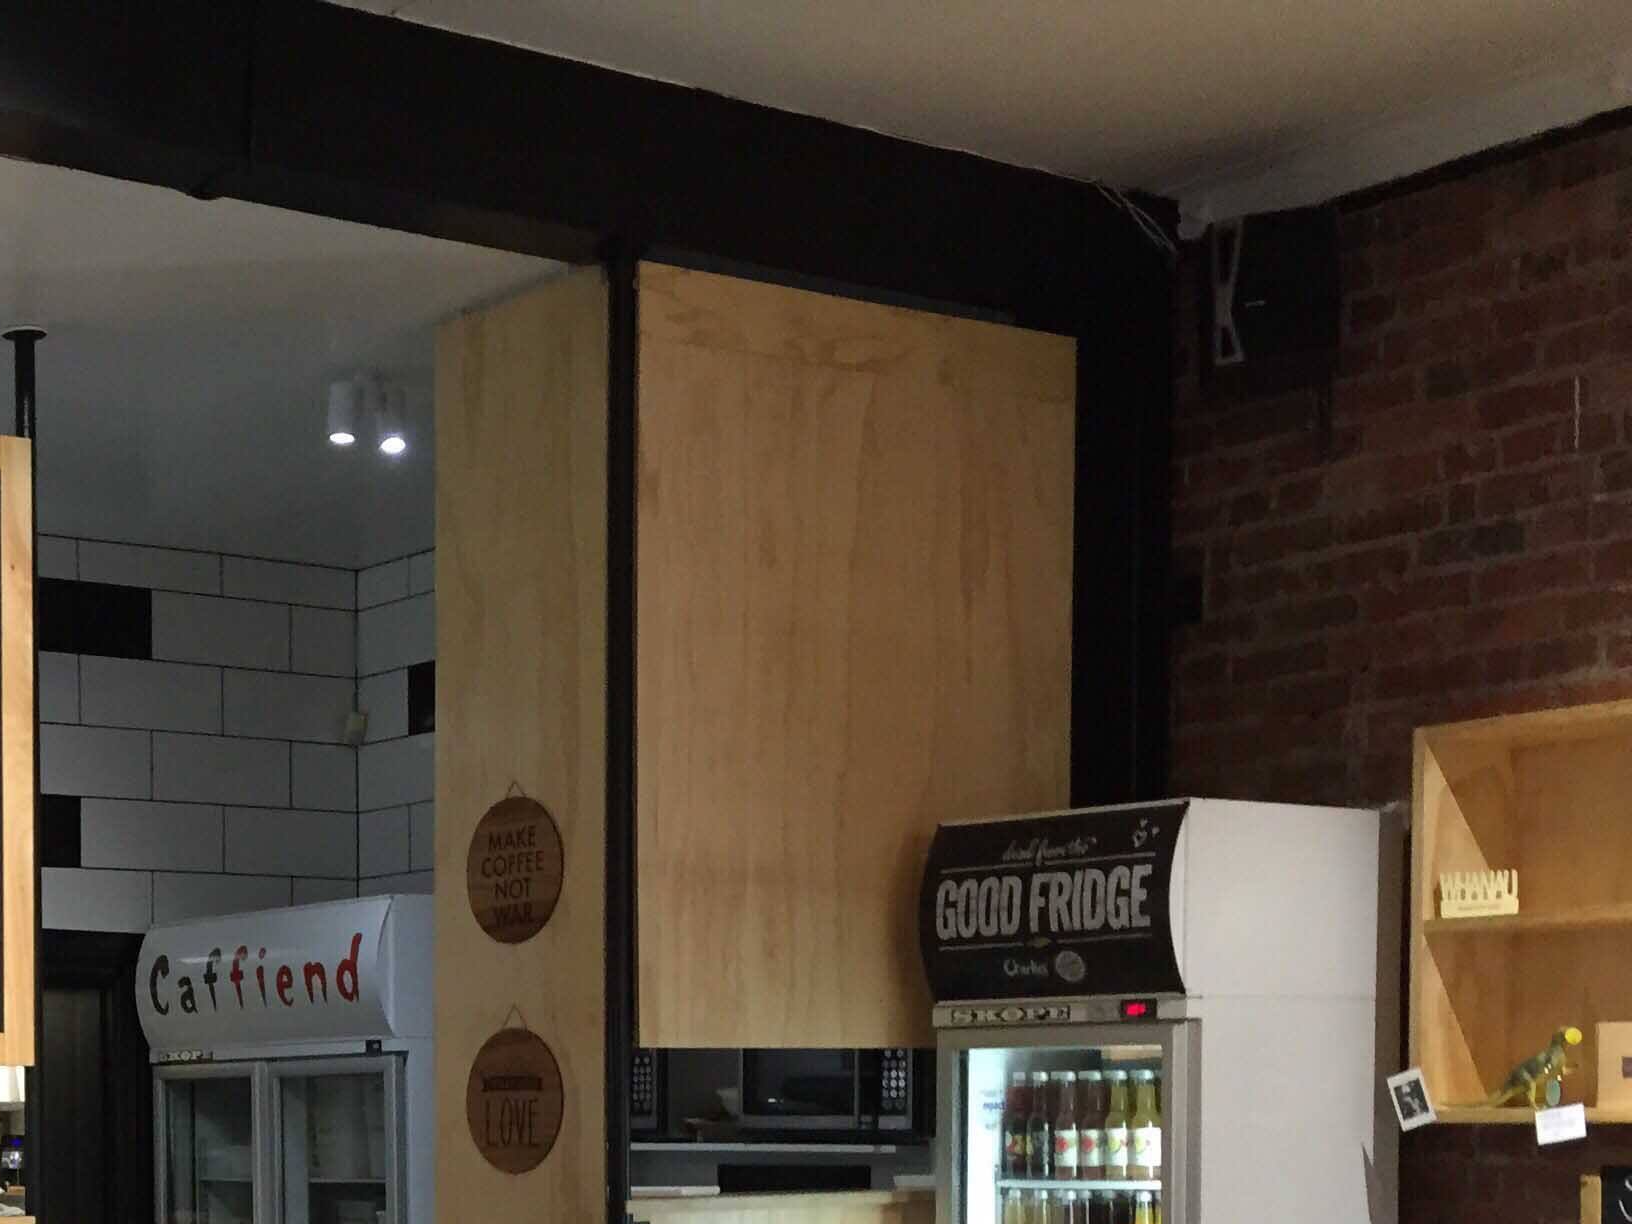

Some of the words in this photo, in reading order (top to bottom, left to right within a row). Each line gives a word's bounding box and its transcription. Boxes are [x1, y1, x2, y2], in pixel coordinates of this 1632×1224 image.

[488, 825, 537, 851] MAKE
[481, 850, 545, 878] COFFEE
[495, 878, 532, 899] NOT
[936, 875, 1023, 941] GOOD
[1029, 863, 1153, 934] FRIDGE
[149, 932, 363, 1016] Caffiend
[485, 1097, 542, 1148] LOVE
